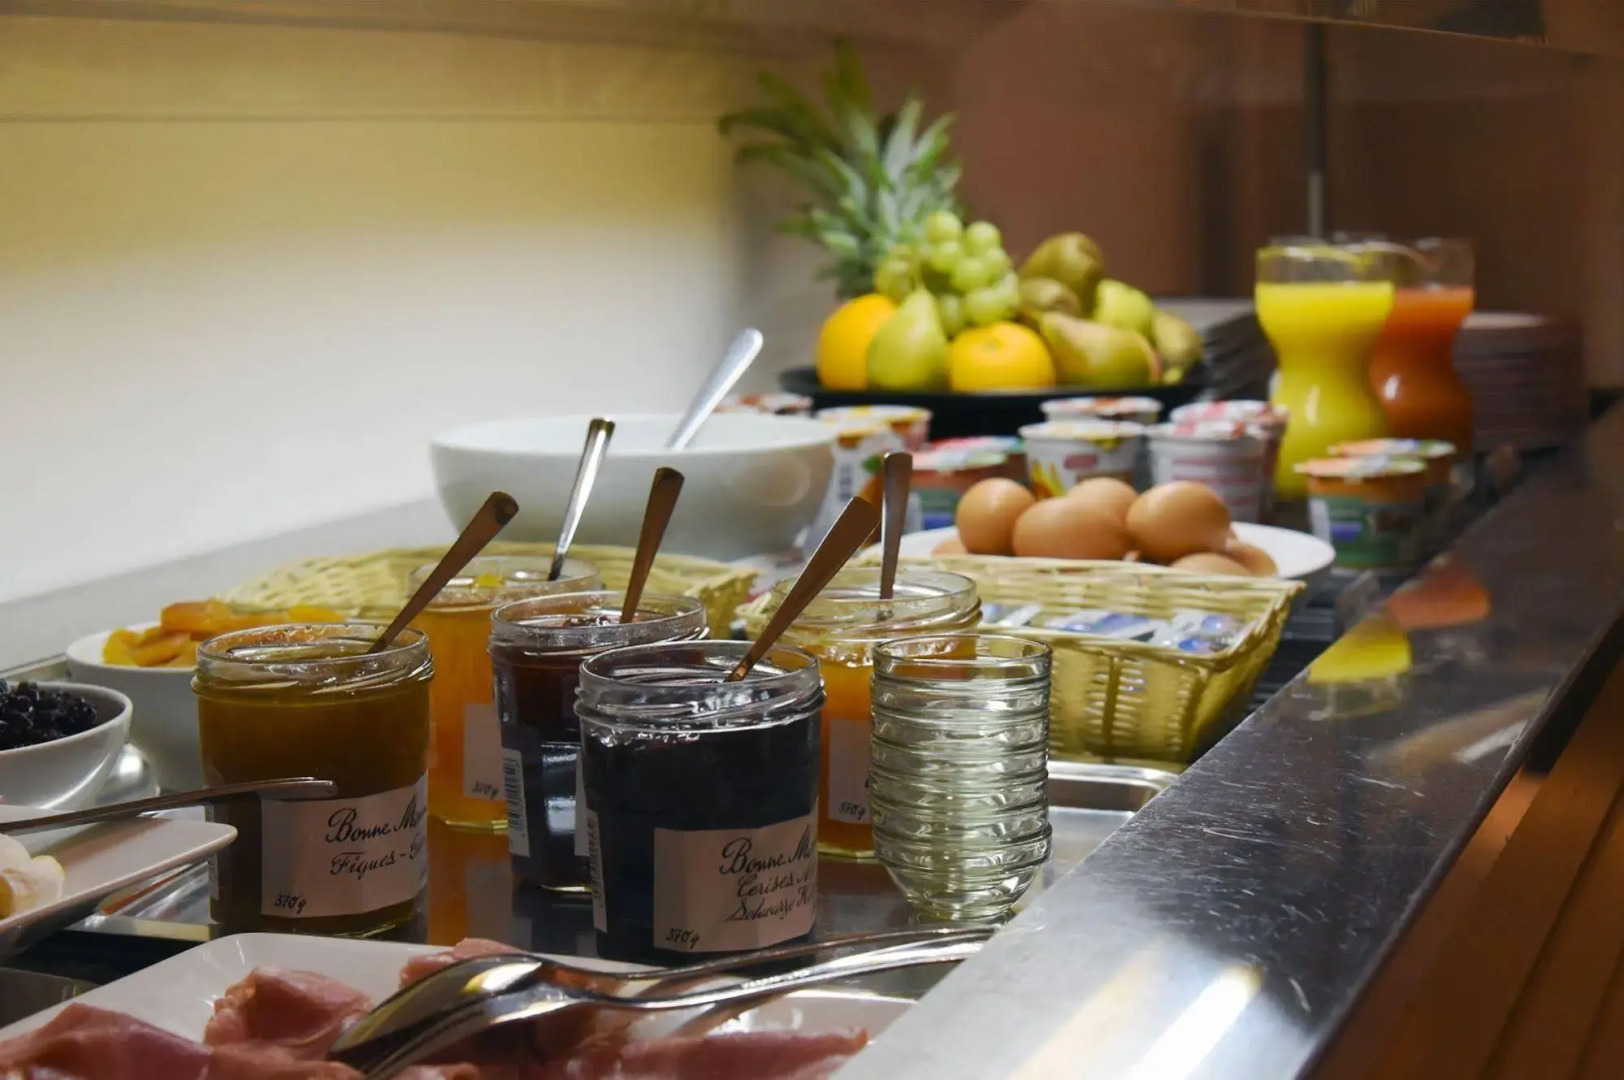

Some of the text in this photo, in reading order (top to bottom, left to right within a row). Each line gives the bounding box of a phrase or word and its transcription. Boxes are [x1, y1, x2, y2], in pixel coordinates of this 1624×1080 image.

[325, 807, 392, 843] Bonne
[330, 851, 396, 881] Figues
[718, 836, 787, 875] Bonne
[737, 873, 794, 898] Cerises
